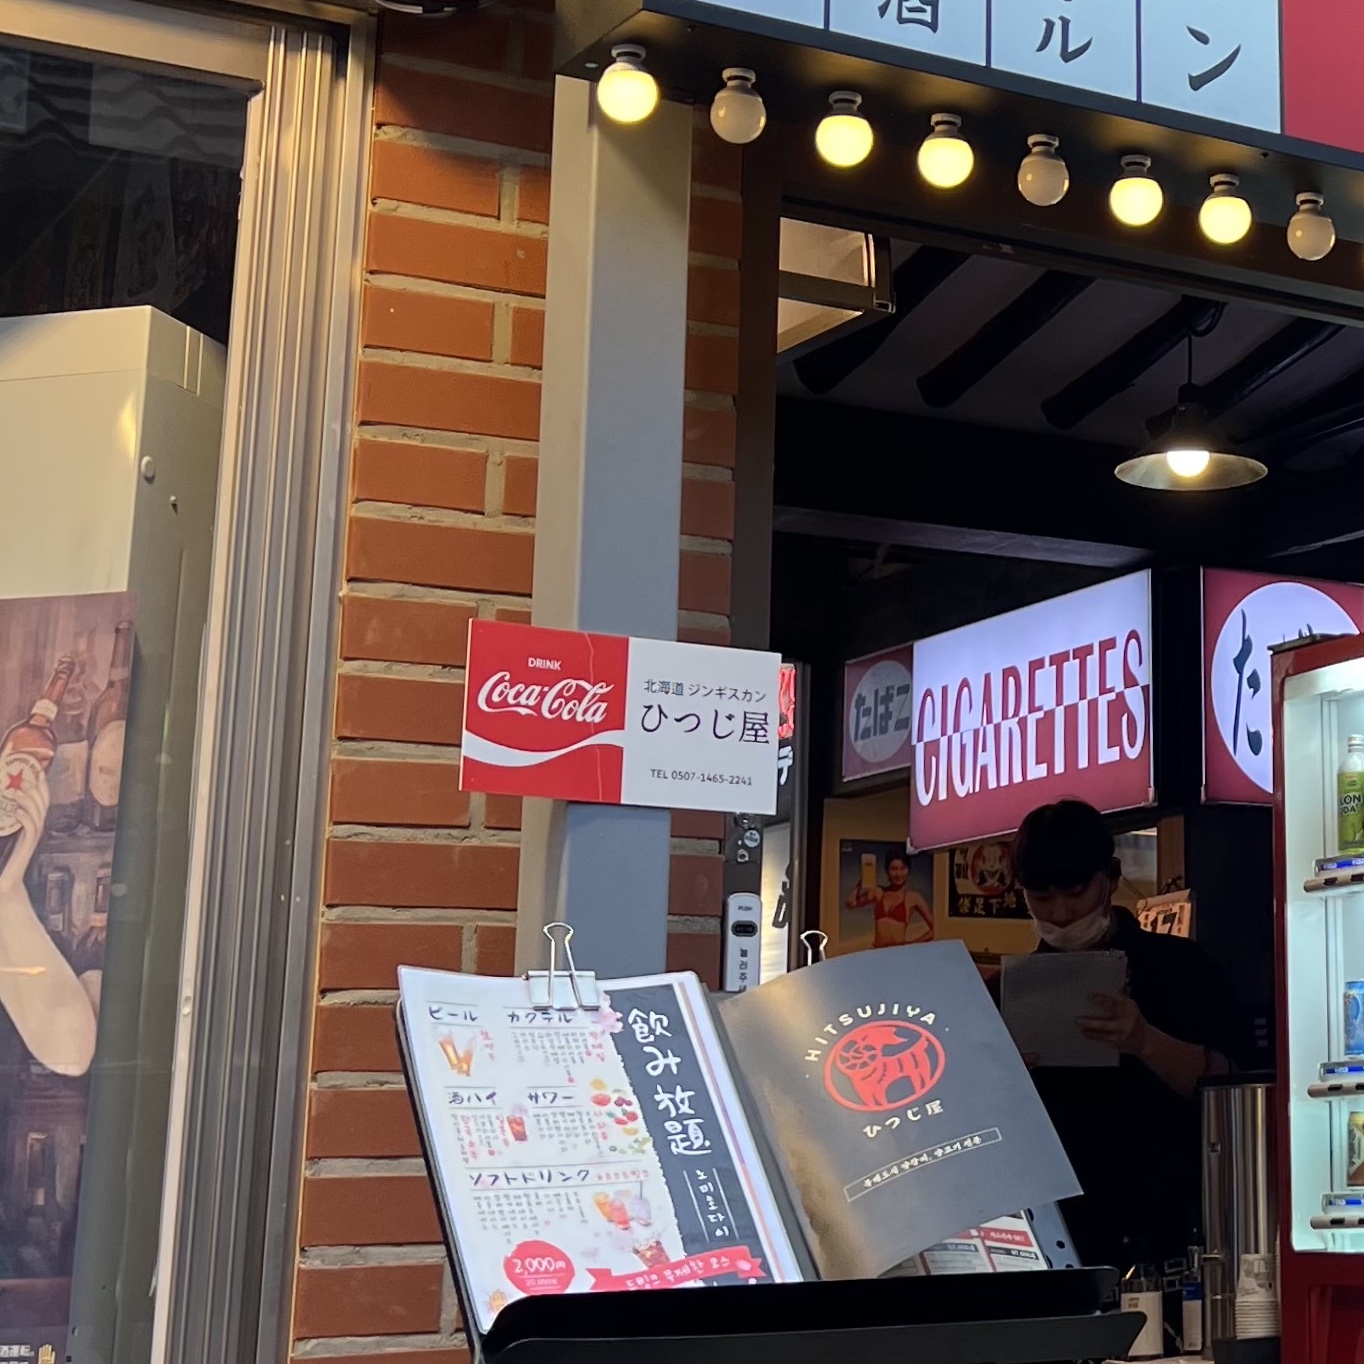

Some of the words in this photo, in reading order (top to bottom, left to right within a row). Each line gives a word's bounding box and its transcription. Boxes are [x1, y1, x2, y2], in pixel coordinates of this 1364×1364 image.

[527, 656, 562, 671] DRINK
[476, 670, 615, 724] Coca-Cola
[643, 678, 684, 697] 北海道
[687, 683, 767, 703] ジンギスカン
[639, 702, 771, 745] ひつじ屋
[913, 628, 1150, 807] CIGARETTES
[650, 768, 669, 781] TEL
[804, 1002, 936, 1063] HITSUJIYA
[627, 1006, 713, 1157] 飲み放題
[862, 1098, 944, 1139] ひつじ屋
